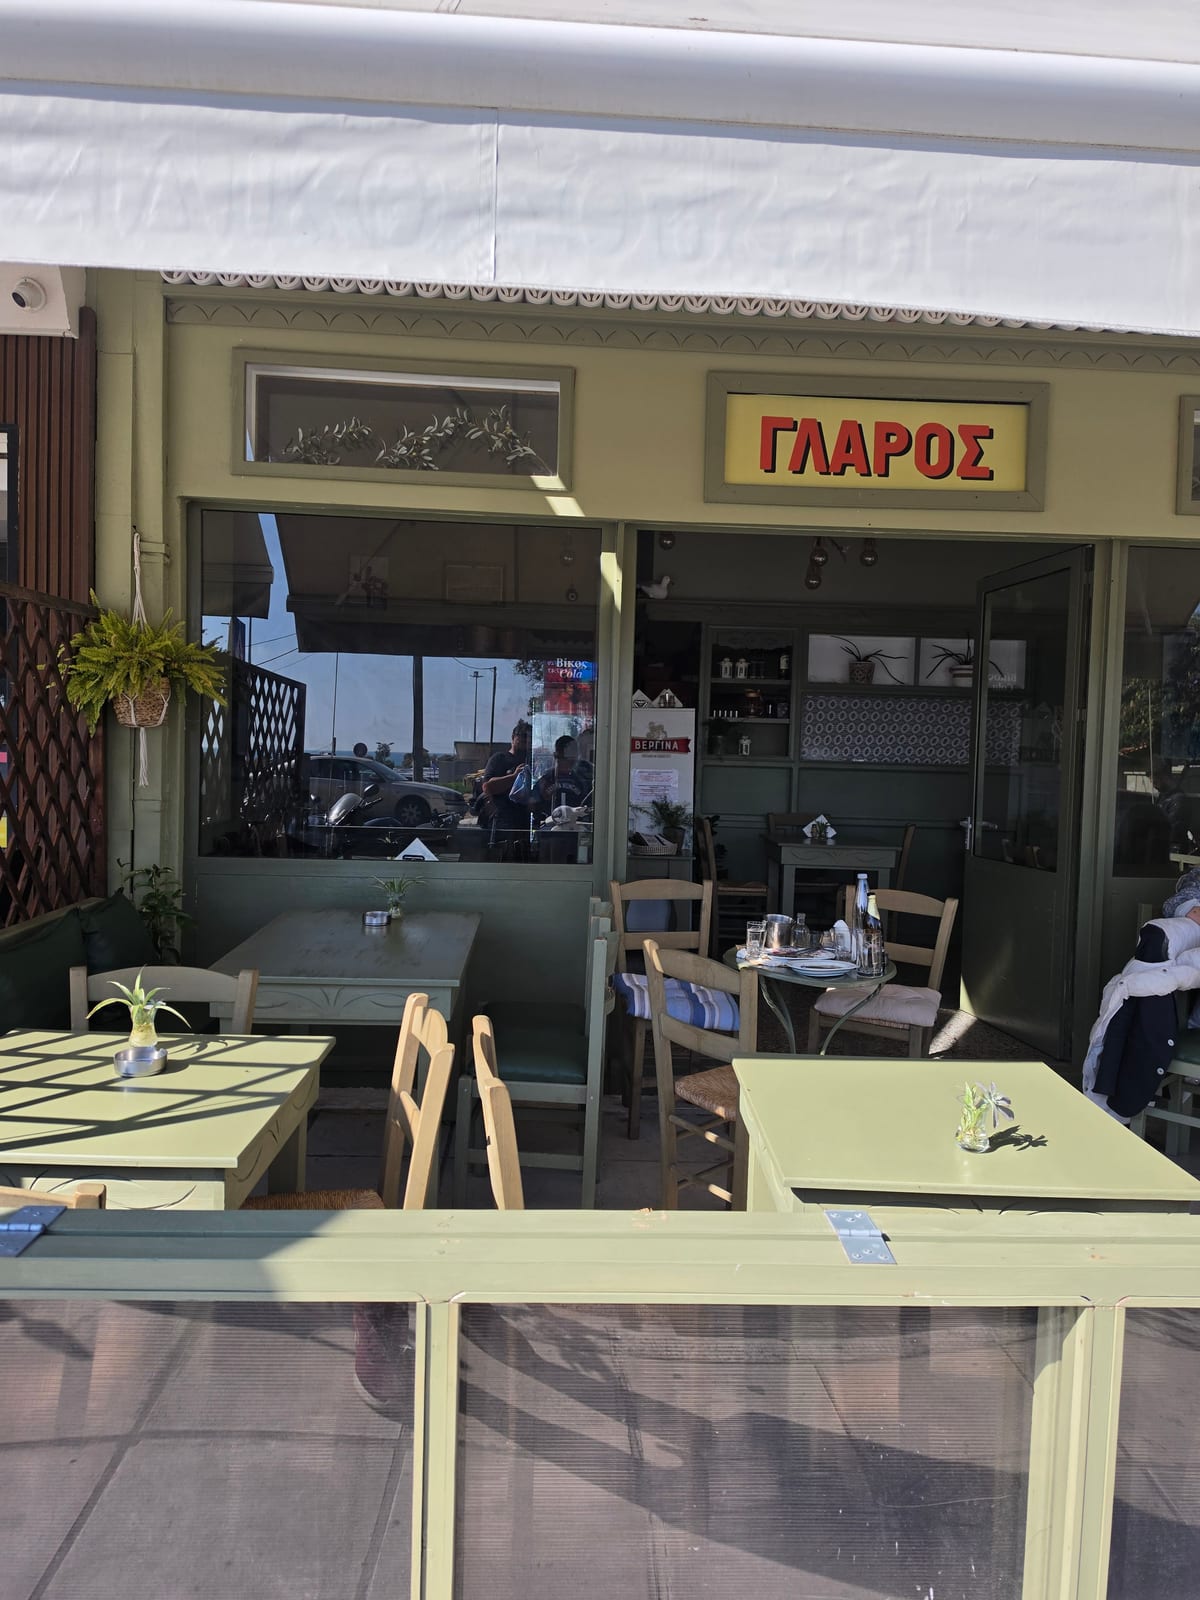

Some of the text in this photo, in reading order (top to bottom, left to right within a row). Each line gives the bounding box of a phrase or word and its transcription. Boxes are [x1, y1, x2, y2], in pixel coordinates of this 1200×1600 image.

[759, 416, 994, 480] ΓΛΑΡΟΣ
[560, 669, 583, 679] Cola
[634, 740, 679, 750] ΒΕΡΓΙΝΑ
